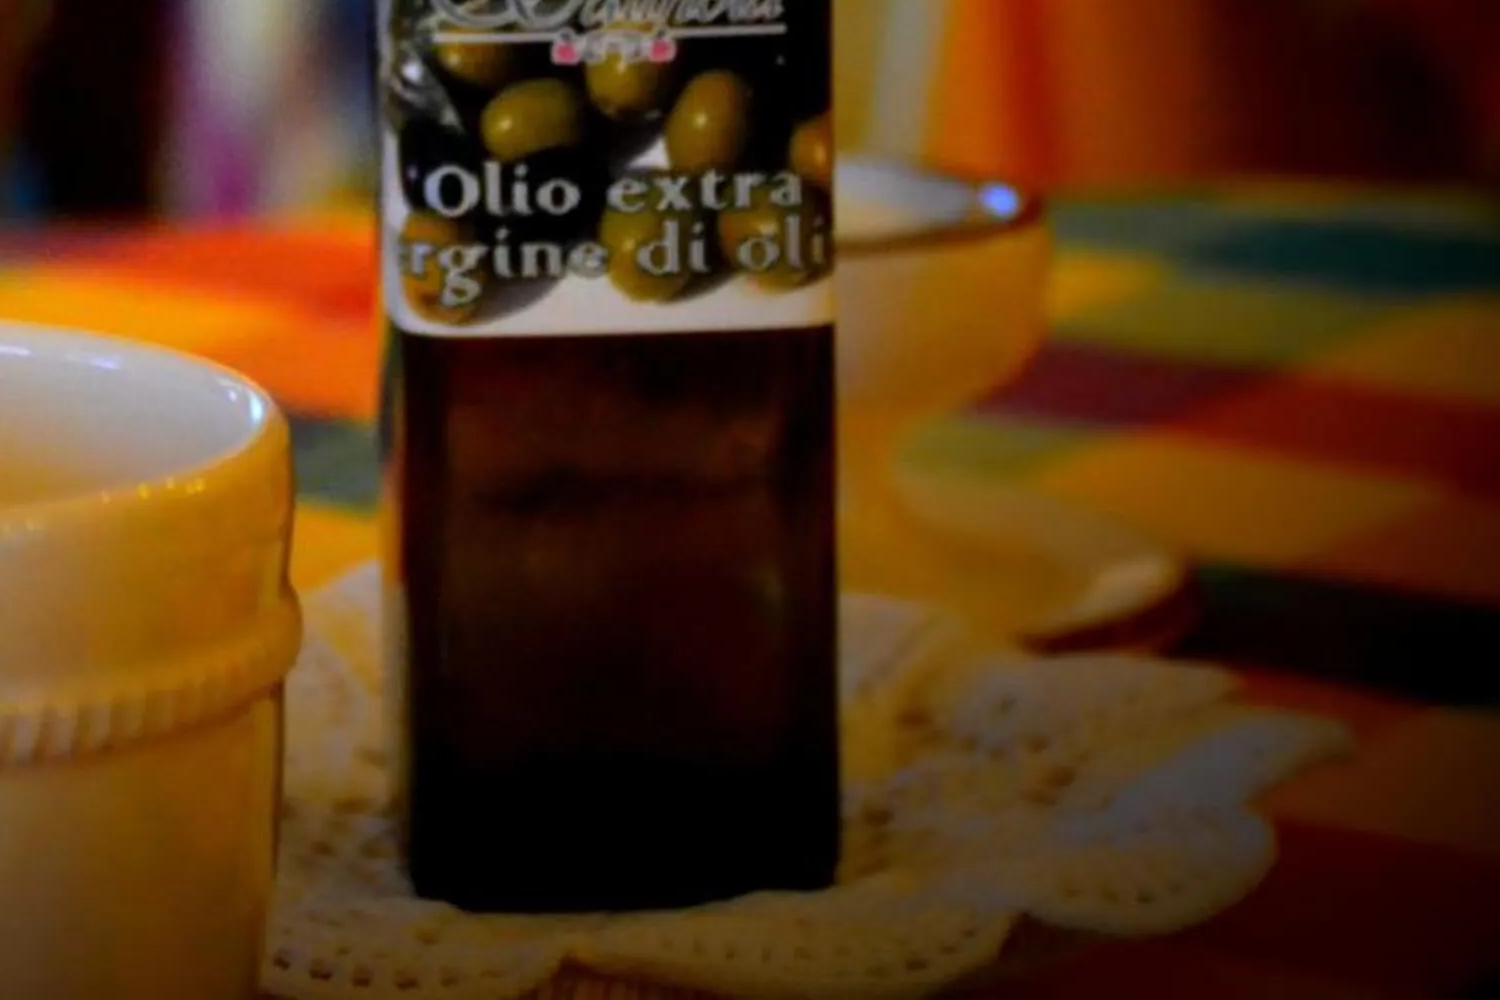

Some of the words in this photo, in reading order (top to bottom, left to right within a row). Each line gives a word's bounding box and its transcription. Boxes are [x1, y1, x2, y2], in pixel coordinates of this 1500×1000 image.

[606, 168, 803, 213] extra
[400, 226, 609, 307] rgine
[637, 218, 710, 275] di
